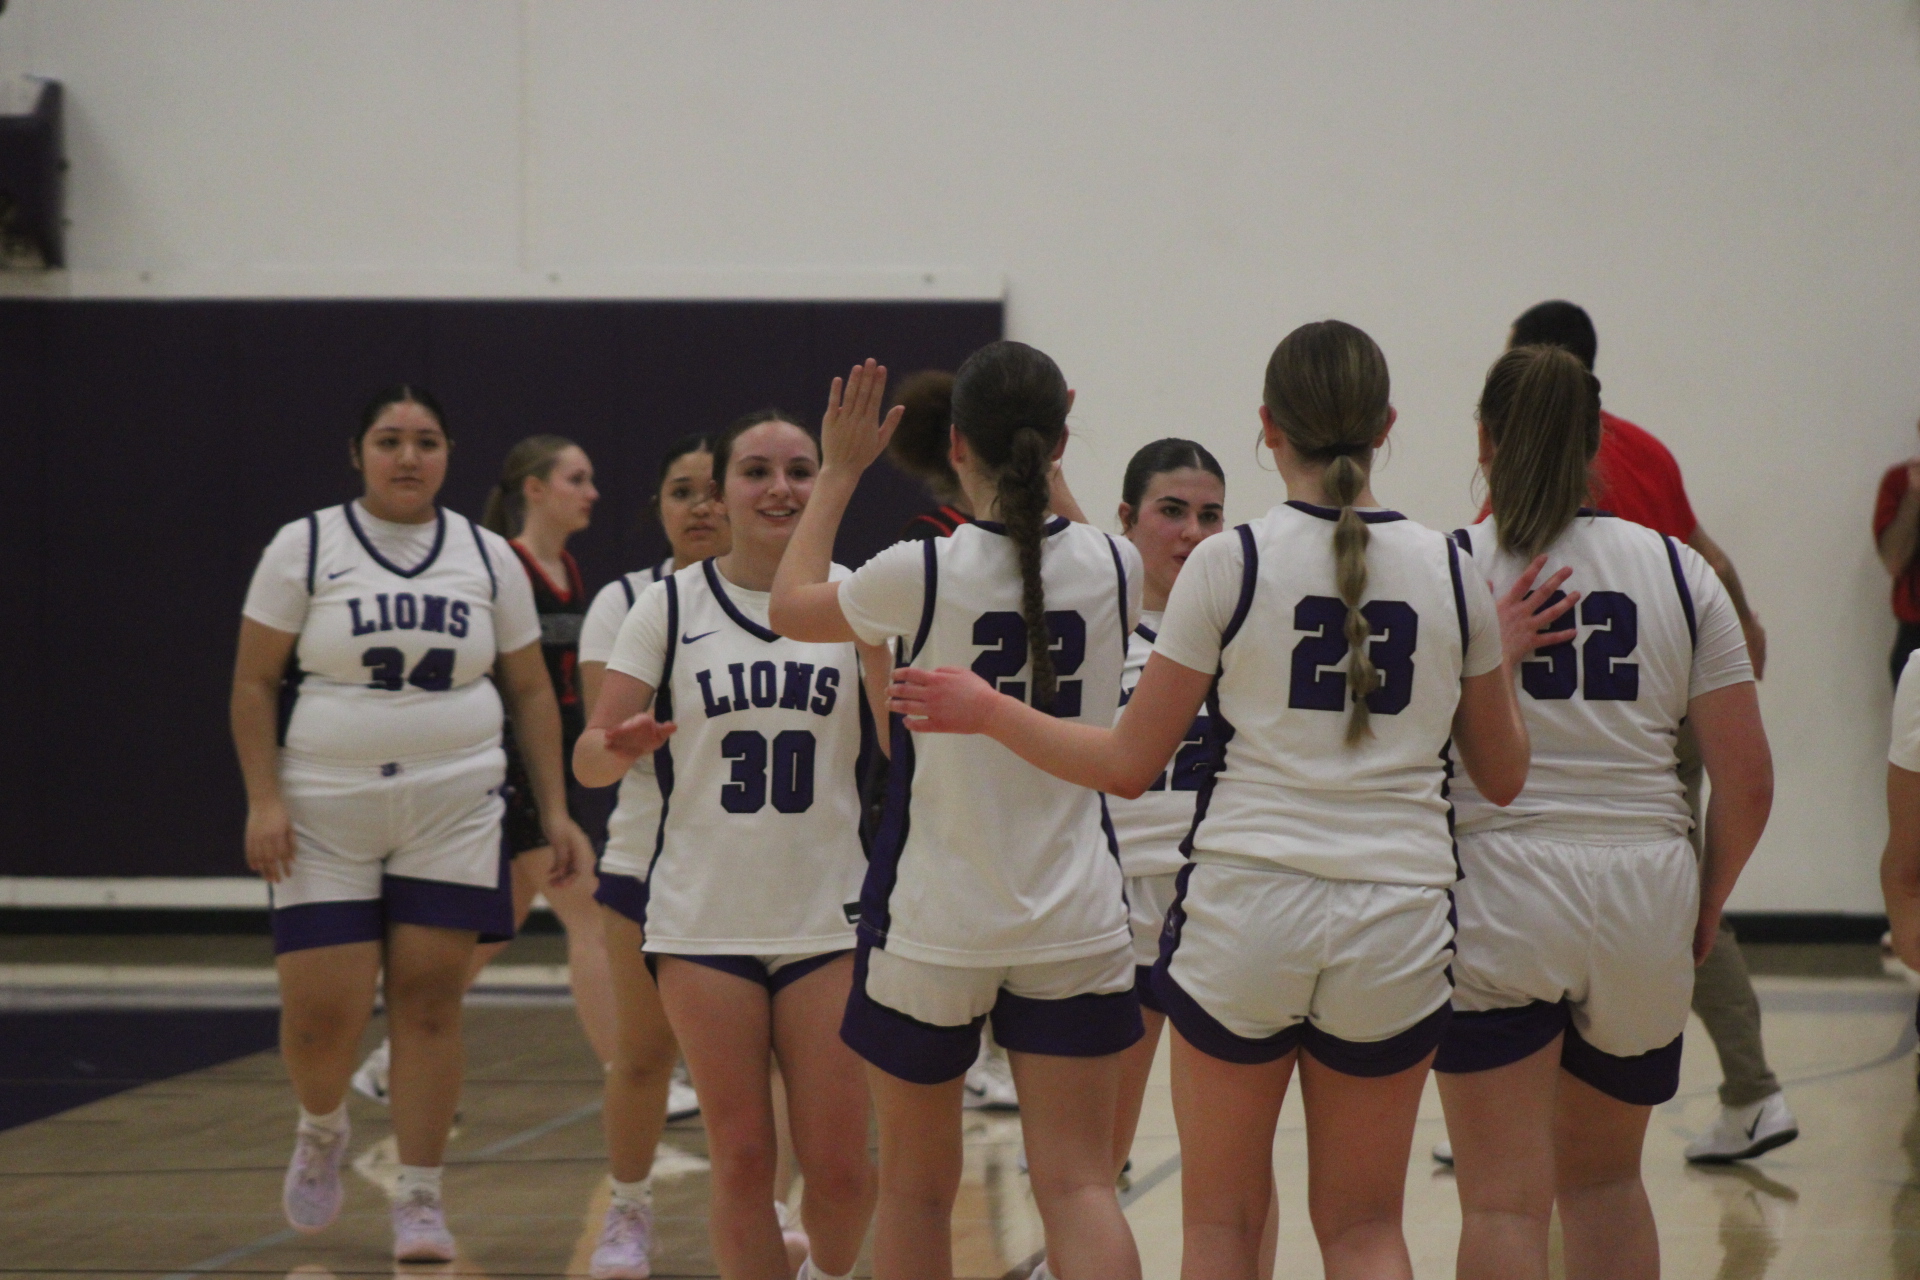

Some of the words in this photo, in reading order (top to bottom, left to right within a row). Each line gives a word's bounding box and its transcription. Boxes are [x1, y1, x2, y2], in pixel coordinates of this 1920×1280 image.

[347, 592, 470, 638] LIONS
[1288, 595, 1418, 715] 23
[1521, 589, 1639, 701] 32
[361, 646, 456, 691] 34
[696, 660, 841, 718] LIONS
[970, 610, 1086, 718] 22
[720, 729, 817, 814] 30
